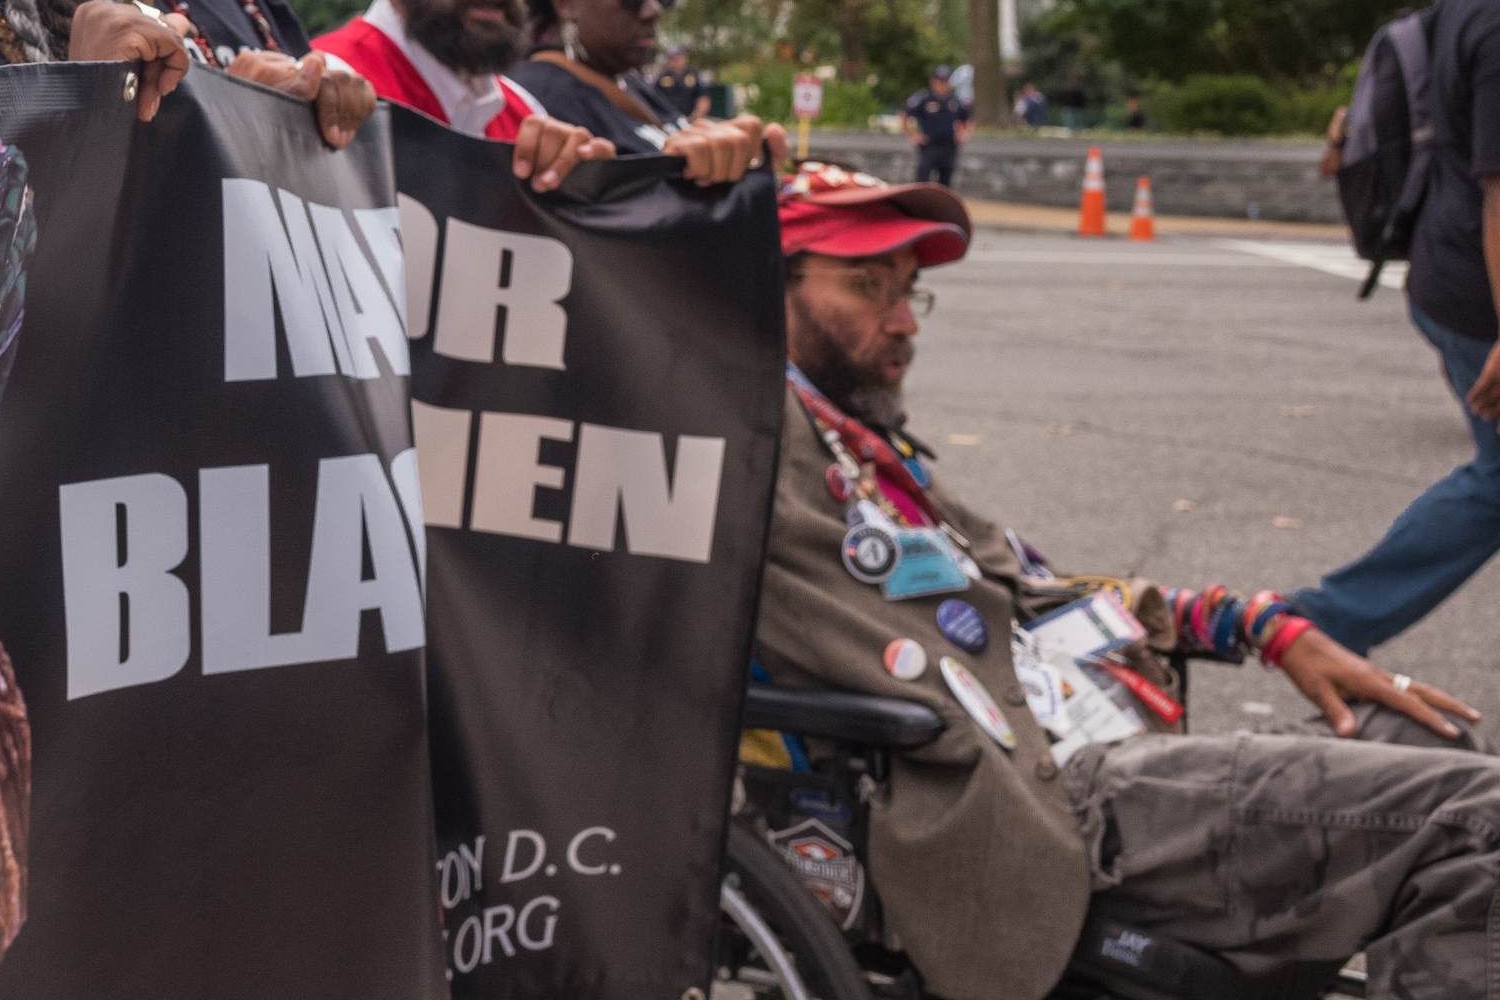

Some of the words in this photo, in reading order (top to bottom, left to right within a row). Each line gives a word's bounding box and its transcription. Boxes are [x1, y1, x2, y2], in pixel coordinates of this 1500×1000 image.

[436, 834, 487, 910] ON
[500, 825, 622, 884] D.C.
[442, 894, 561, 982] .ORG
